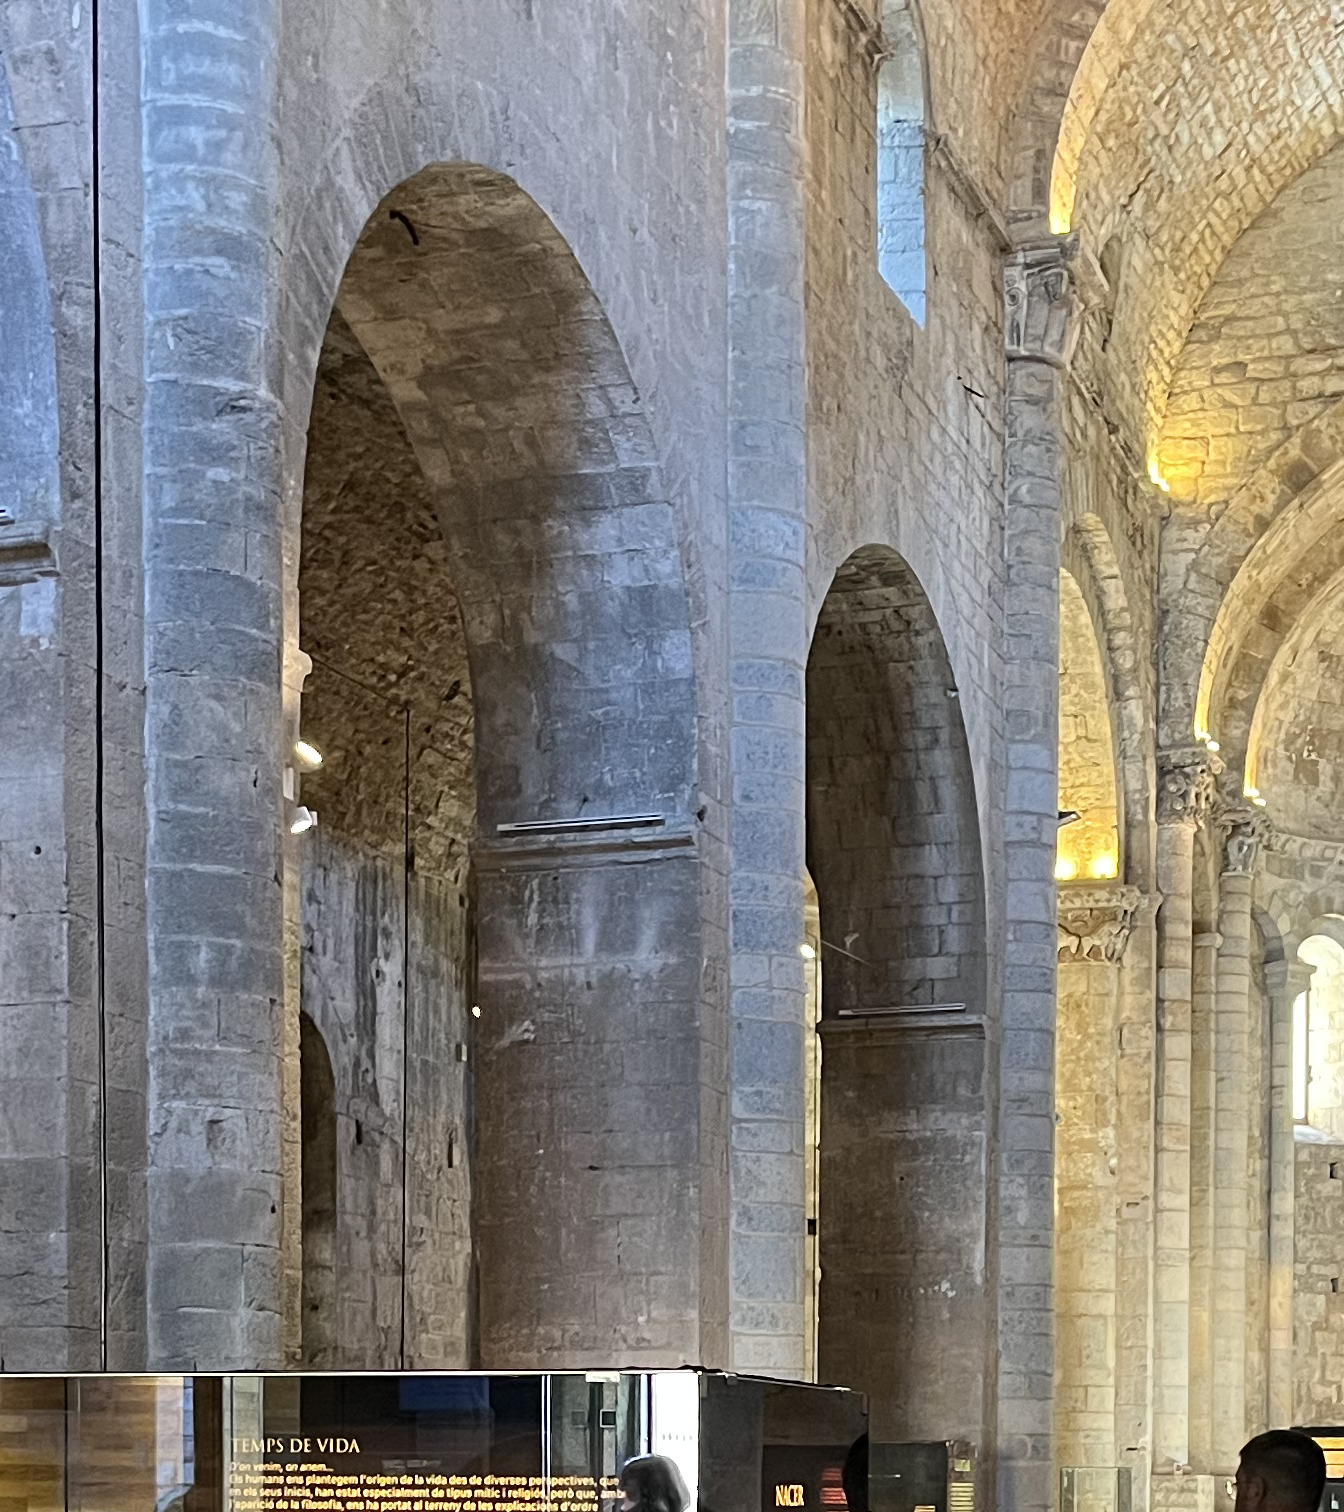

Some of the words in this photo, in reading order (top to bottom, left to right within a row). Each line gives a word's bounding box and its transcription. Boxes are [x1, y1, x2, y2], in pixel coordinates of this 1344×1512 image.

[232, 1438, 284, 1453] TEMPS
[290, 1438, 312, 1453] DE
[317, 1438, 360, 1453] VIDA
[229, 1474, 242, 1484] Els
[244, 1475, 284, 1485] humans
[286, 1477, 304, 1485] ens
[306, 1475, 358, 1487] plantegem
[360, 1475, 398, 1487] l'origen
[400, 1475, 412, 1485] de
[414, 1475, 423, 1485] la
[425, 1475, 446, 1485] vida
[448, 1475, 466, 1485] des
[468, 1475, 482, 1485] de
[484, 1475, 526, 1485] diverses
[528, 1476, 597, 1488] perspectives,
[599, 1478, 619, 1488] que
[775, 1484, 804, 1506] NACER
